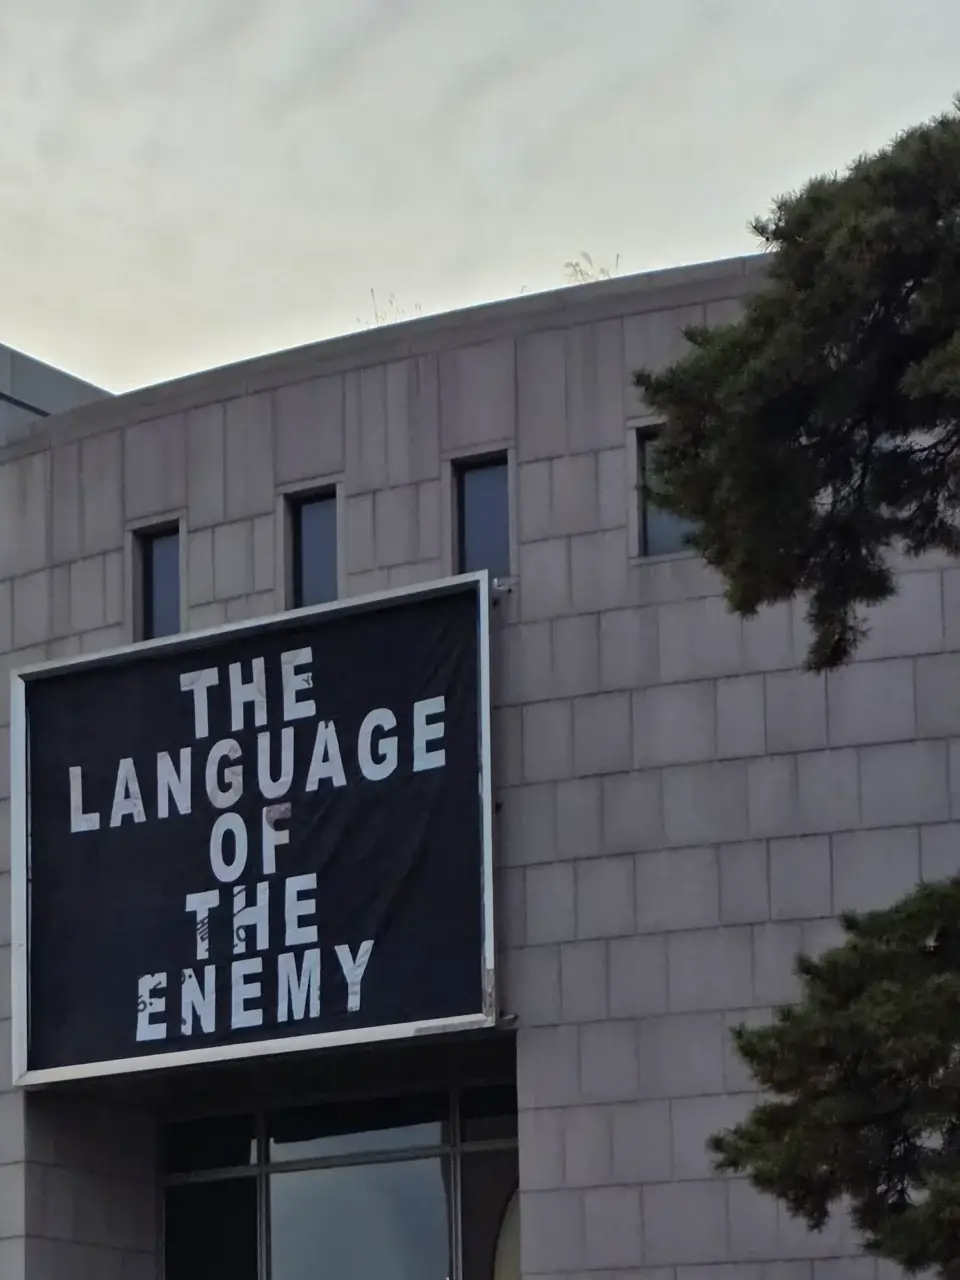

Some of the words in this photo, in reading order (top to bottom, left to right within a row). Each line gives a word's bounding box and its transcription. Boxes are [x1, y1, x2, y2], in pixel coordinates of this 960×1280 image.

[180, 646, 317, 740] THE
[68, 695, 447, 834] LANGUAGE
[209, 801, 293, 883] OF
[185, 872, 319, 961] THE
[135, 939, 375, 1042] ENEMY
